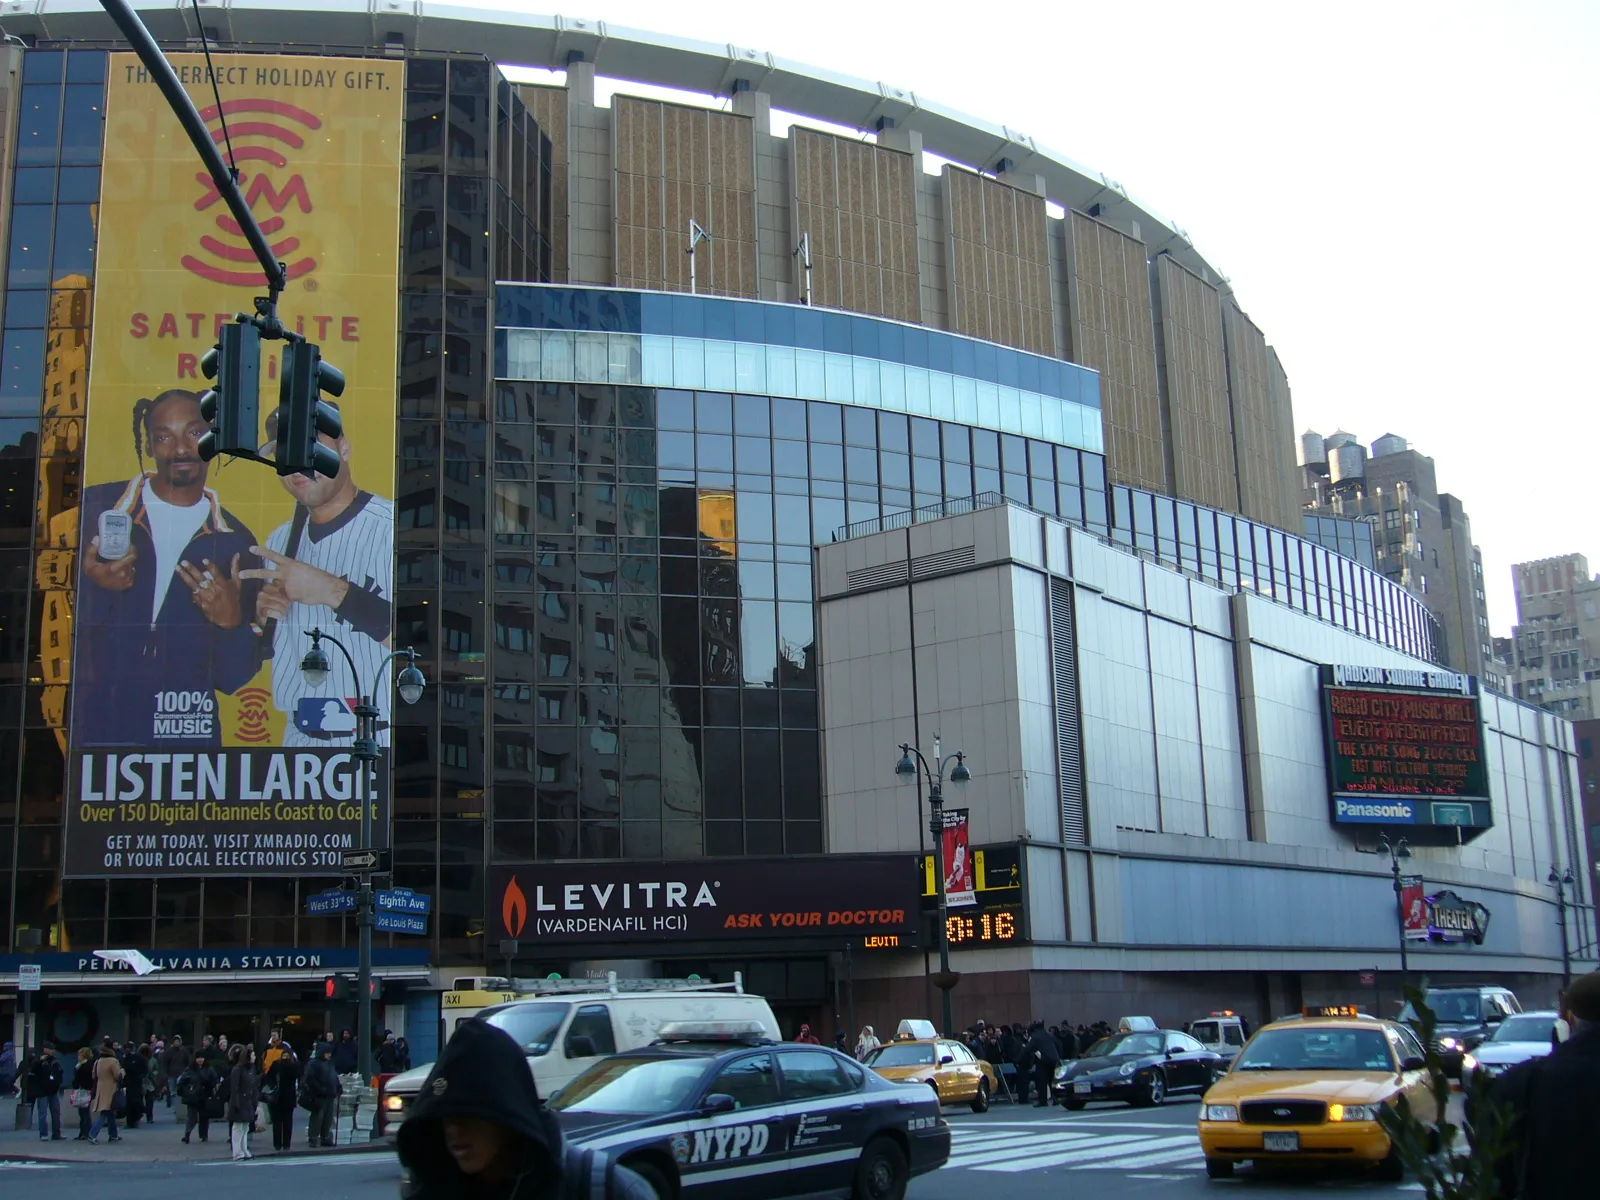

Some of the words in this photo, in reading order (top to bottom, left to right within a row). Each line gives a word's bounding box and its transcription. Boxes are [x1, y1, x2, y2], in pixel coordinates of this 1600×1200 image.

[125, 65, 155, 84] TH
[173, 65, 248, 85] ERFECT
[255, 68, 337, 88] HOLIDAY
[344, 71, 390, 91] GIFT.
[194, 172, 313, 213] XM
[1332, 663, 1383, 686] MADISON
[1385, 669, 1426, 688] SQUARE
[1428, 672, 1471, 695] GARDEN
[154, 691, 214, 712] 100%
[1371, 699, 1399, 719] CITY
[1402, 700, 1441, 719] MUSIC
[154, 720, 213, 735] MUSIC
[1361, 743, 1390, 758] SAME
[80, 754, 226, 801] LISTEN
[80, 803, 115, 822] Over
[118, 803, 146, 822] 150
[149, 802, 199, 826] Digital
[202, 802, 271, 821] Channels
[275, 802, 315, 821] Coast
[318, 803, 334, 821] to
[337, 802, 378, 820] Coat
[1336, 800, 1412, 818] Panasonic
[106, 835, 132, 850] GET
[136, 835, 156, 850] XM
[161, 834, 208, 849] TODAY.
[213, 834, 249, 848] VISIT
[254, 833, 353, 848] XMRADIO.COM
[104, 852, 122, 867] OR
[127, 852, 163, 867] YOUR
[168, 852, 210, 867] LOCAL
[215, 851, 307, 866] ELECTRONICS
[310, 901, 329, 911] West
[346, 896, 354, 906] St
[379, 895, 407, 908] Eighth
[409, 898, 425, 909] Ave
[378, 917, 389, 926] Joe
[390, 917, 406, 928] Louis
[407, 919, 424, 930] Plaza
[724, 913, 763, 928] ASK
[769, 912, 822, 927] YOUR
[828, 909, 905, 925] DOCTOR
[1432, 903, 1475, 930] THEATER
[536, 917, 647, 935] (VARDENAFIL
[241, 954, 321, 969] STATION
[444, 995, 461, 1005] TAXI
[690, 1123, 770, 1164] NYPD
